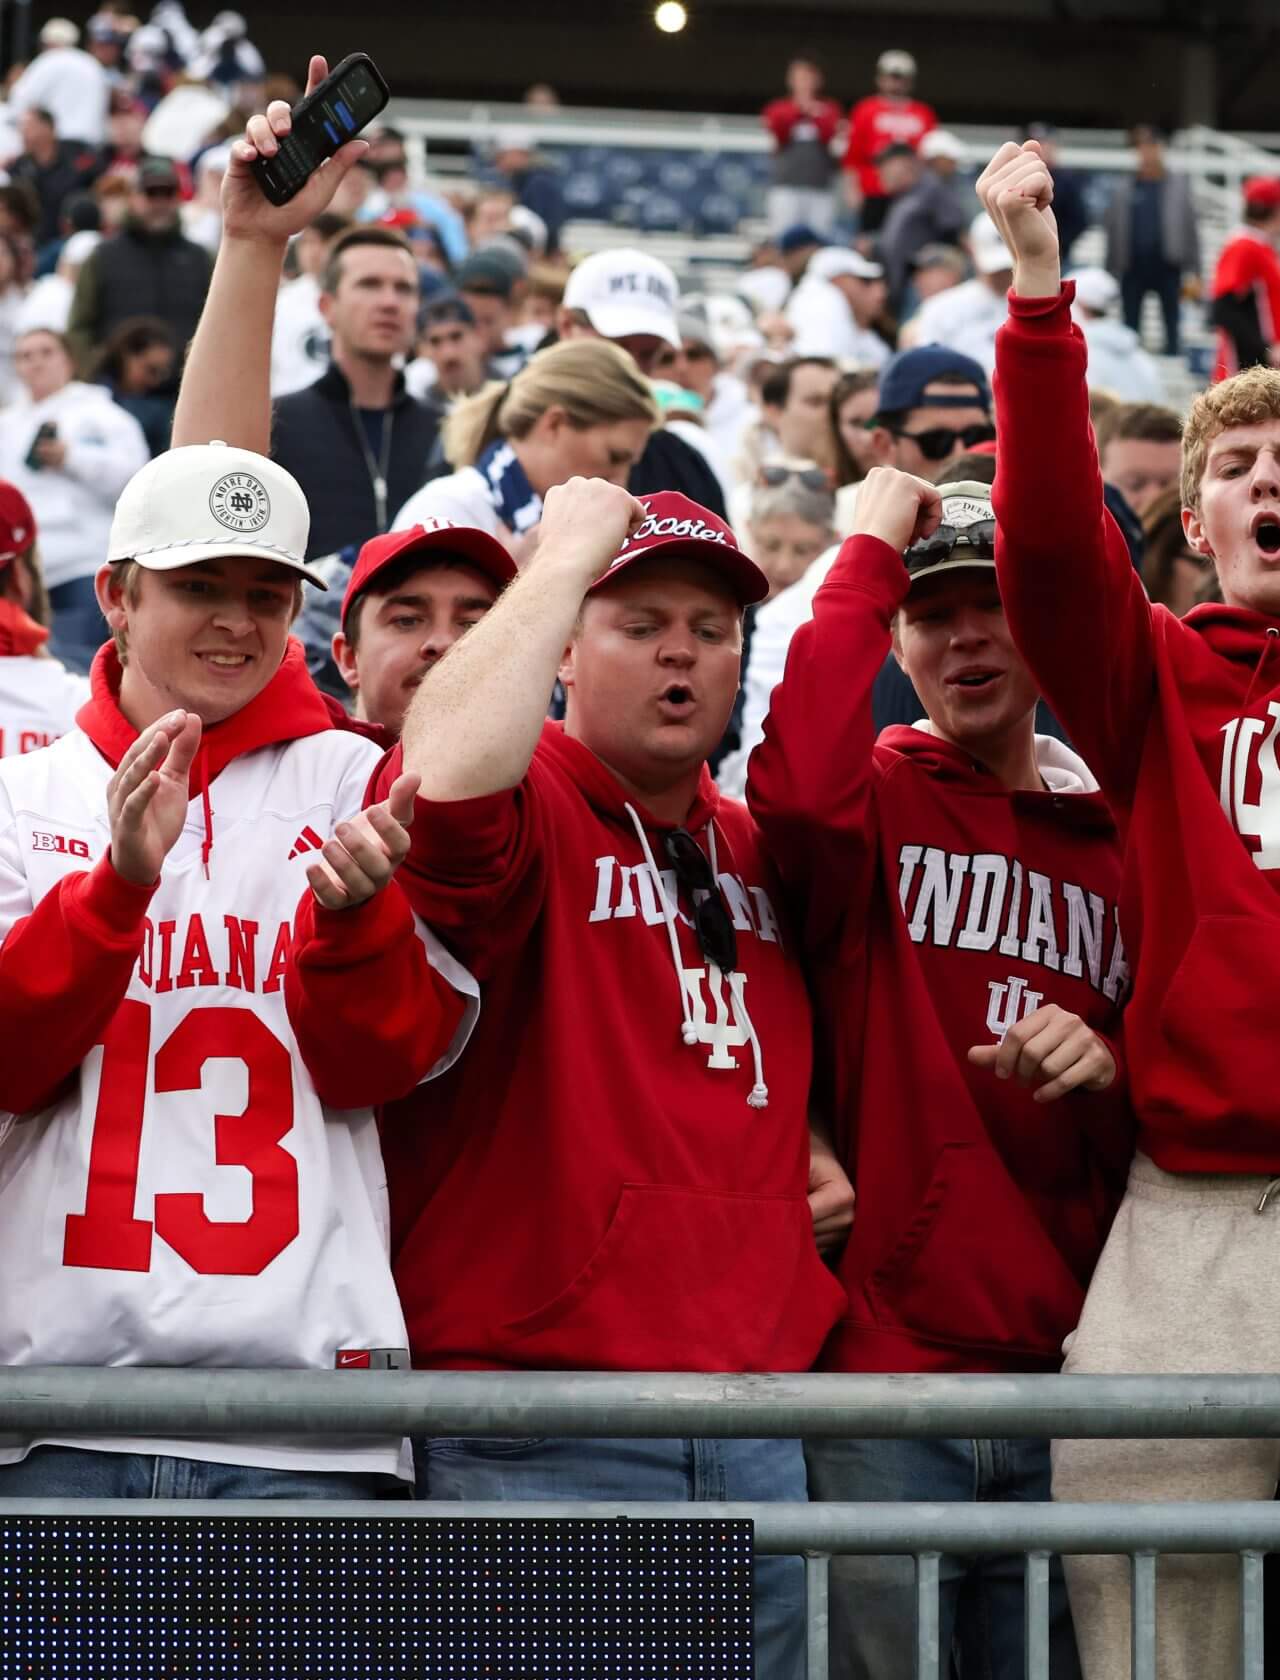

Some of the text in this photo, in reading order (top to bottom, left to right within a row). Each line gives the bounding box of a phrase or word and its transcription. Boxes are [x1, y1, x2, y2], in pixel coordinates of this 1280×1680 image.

[215, 476, 266, 502] NOTRE DAME
[633, 501, 736, 549] oosier
[138, 913, 293, 994] DIANA
[62, 997, 300, 1277] 13
